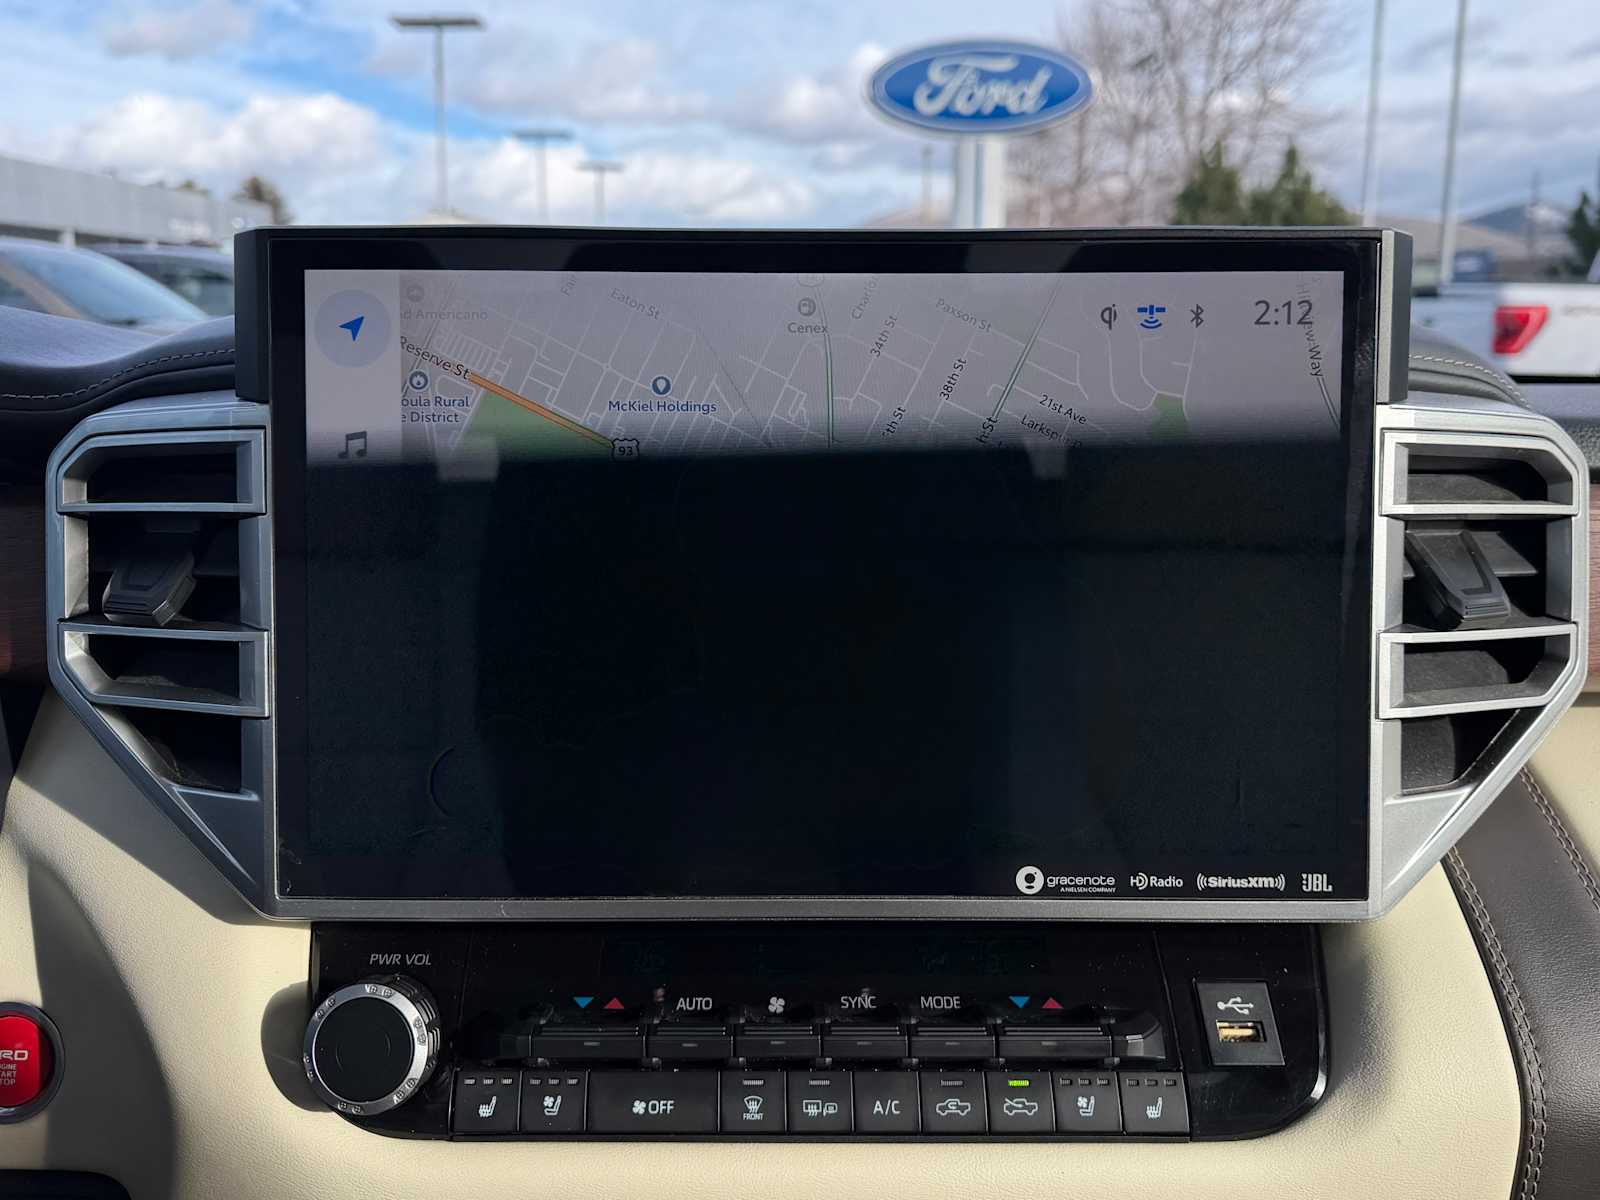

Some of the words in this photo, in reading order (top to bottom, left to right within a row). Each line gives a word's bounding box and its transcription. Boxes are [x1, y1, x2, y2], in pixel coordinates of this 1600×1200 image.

[913, 55, 1052, 116] Ford
[609, 287, 645, 312] Eaton
[647, 305, 660, 320] St
[415, 309, 488, 320] Americano
[936, 298, 976, 328] Paxson
[977, 318, 992, 333] St
[1254, 300, 1313, 326] 2:12
[787, 322, 828, 334] Cenex
[870, 328, 889, 358] 34th
[884, 314, 898, 330] St
[400, 336, 452, 372] Reserve
[452, 363, 470, 381] St
[1308, 345, 1323, 377] Way
[939, 371, 960, 401] 38th
[953, 357, 967, 373] St
[434, 396, 470, 407] Rural
[608, 400, 653, 412] McKiel
[656, 400, 717, 415] Holdings
[1039, 393, 1063, 414] 21st
[1064, 408, 1087, 425] Ave
[410, 411, 459, 423] District
[892, 406, 907, 421] St
[618, 445, 633, 457] 93
[1047, 875, 1115, 888] gracenote
[1150, 872, 1184, 888] Radio
[1301, 873, 1333, 892] JBL
[369, 953, 401, 966] PWR
[405, 953, 432, 966] VOL
[676, 997, 713, 1011] AUTO
[840, 996, 877, 1009] SYNC
[920, 996, 961, 1010] MODE
[648, 1100, 674, 1115] OFF
[873, 1101, 901, 1115] A/C
[742, 1113, 764, 1121] FRONT
